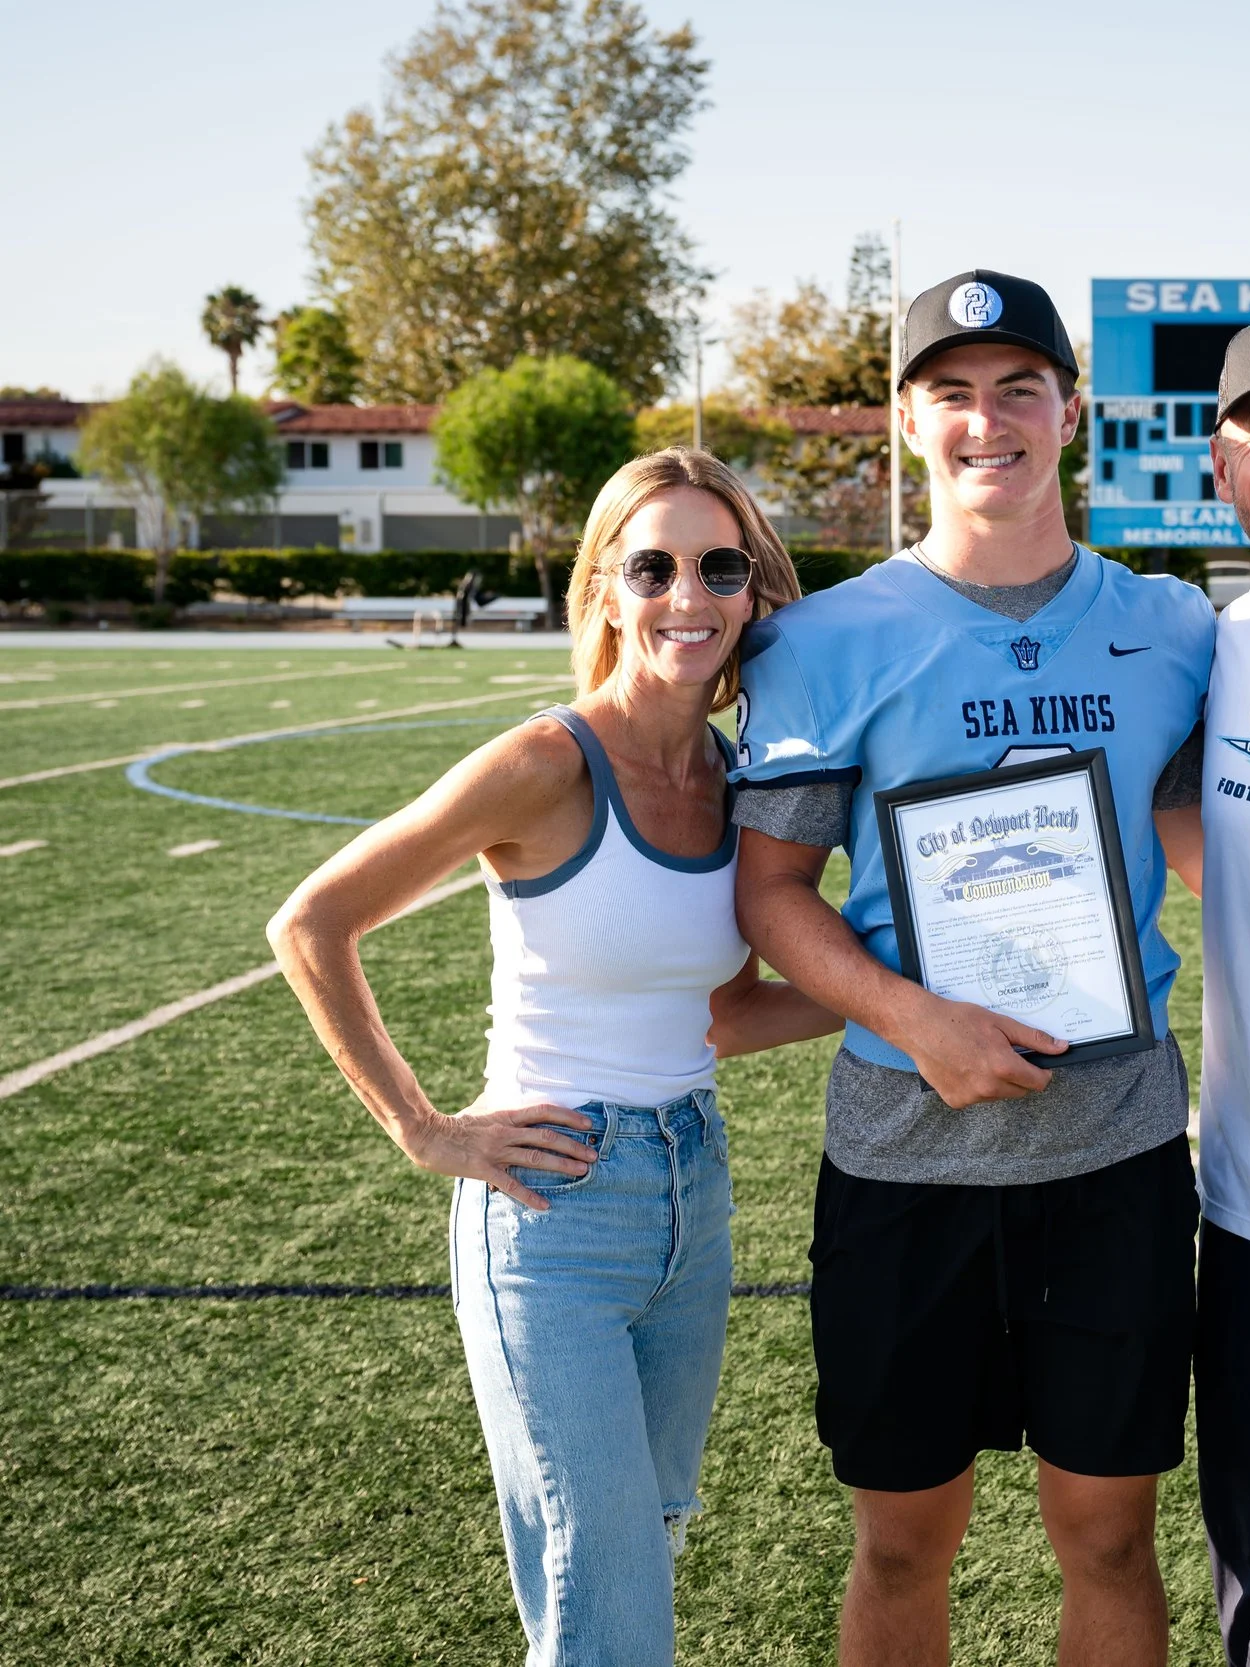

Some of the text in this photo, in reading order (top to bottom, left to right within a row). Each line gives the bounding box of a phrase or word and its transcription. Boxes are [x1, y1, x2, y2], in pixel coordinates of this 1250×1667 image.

[965, 287, 988, 322] 2
[1126, 282, 1221, 313] SEA
[1102, 402, 1157, 420] HOME
[1162, 508, 1234, 526] SEAN
[1123, 528, 1238, 544] MEMORIAL
[962, 694, 1115, 738] SEA KINGS
[916, 805, 1080, 858] City of Newport Beach
[962, 871, 1051, 902] Commendation
